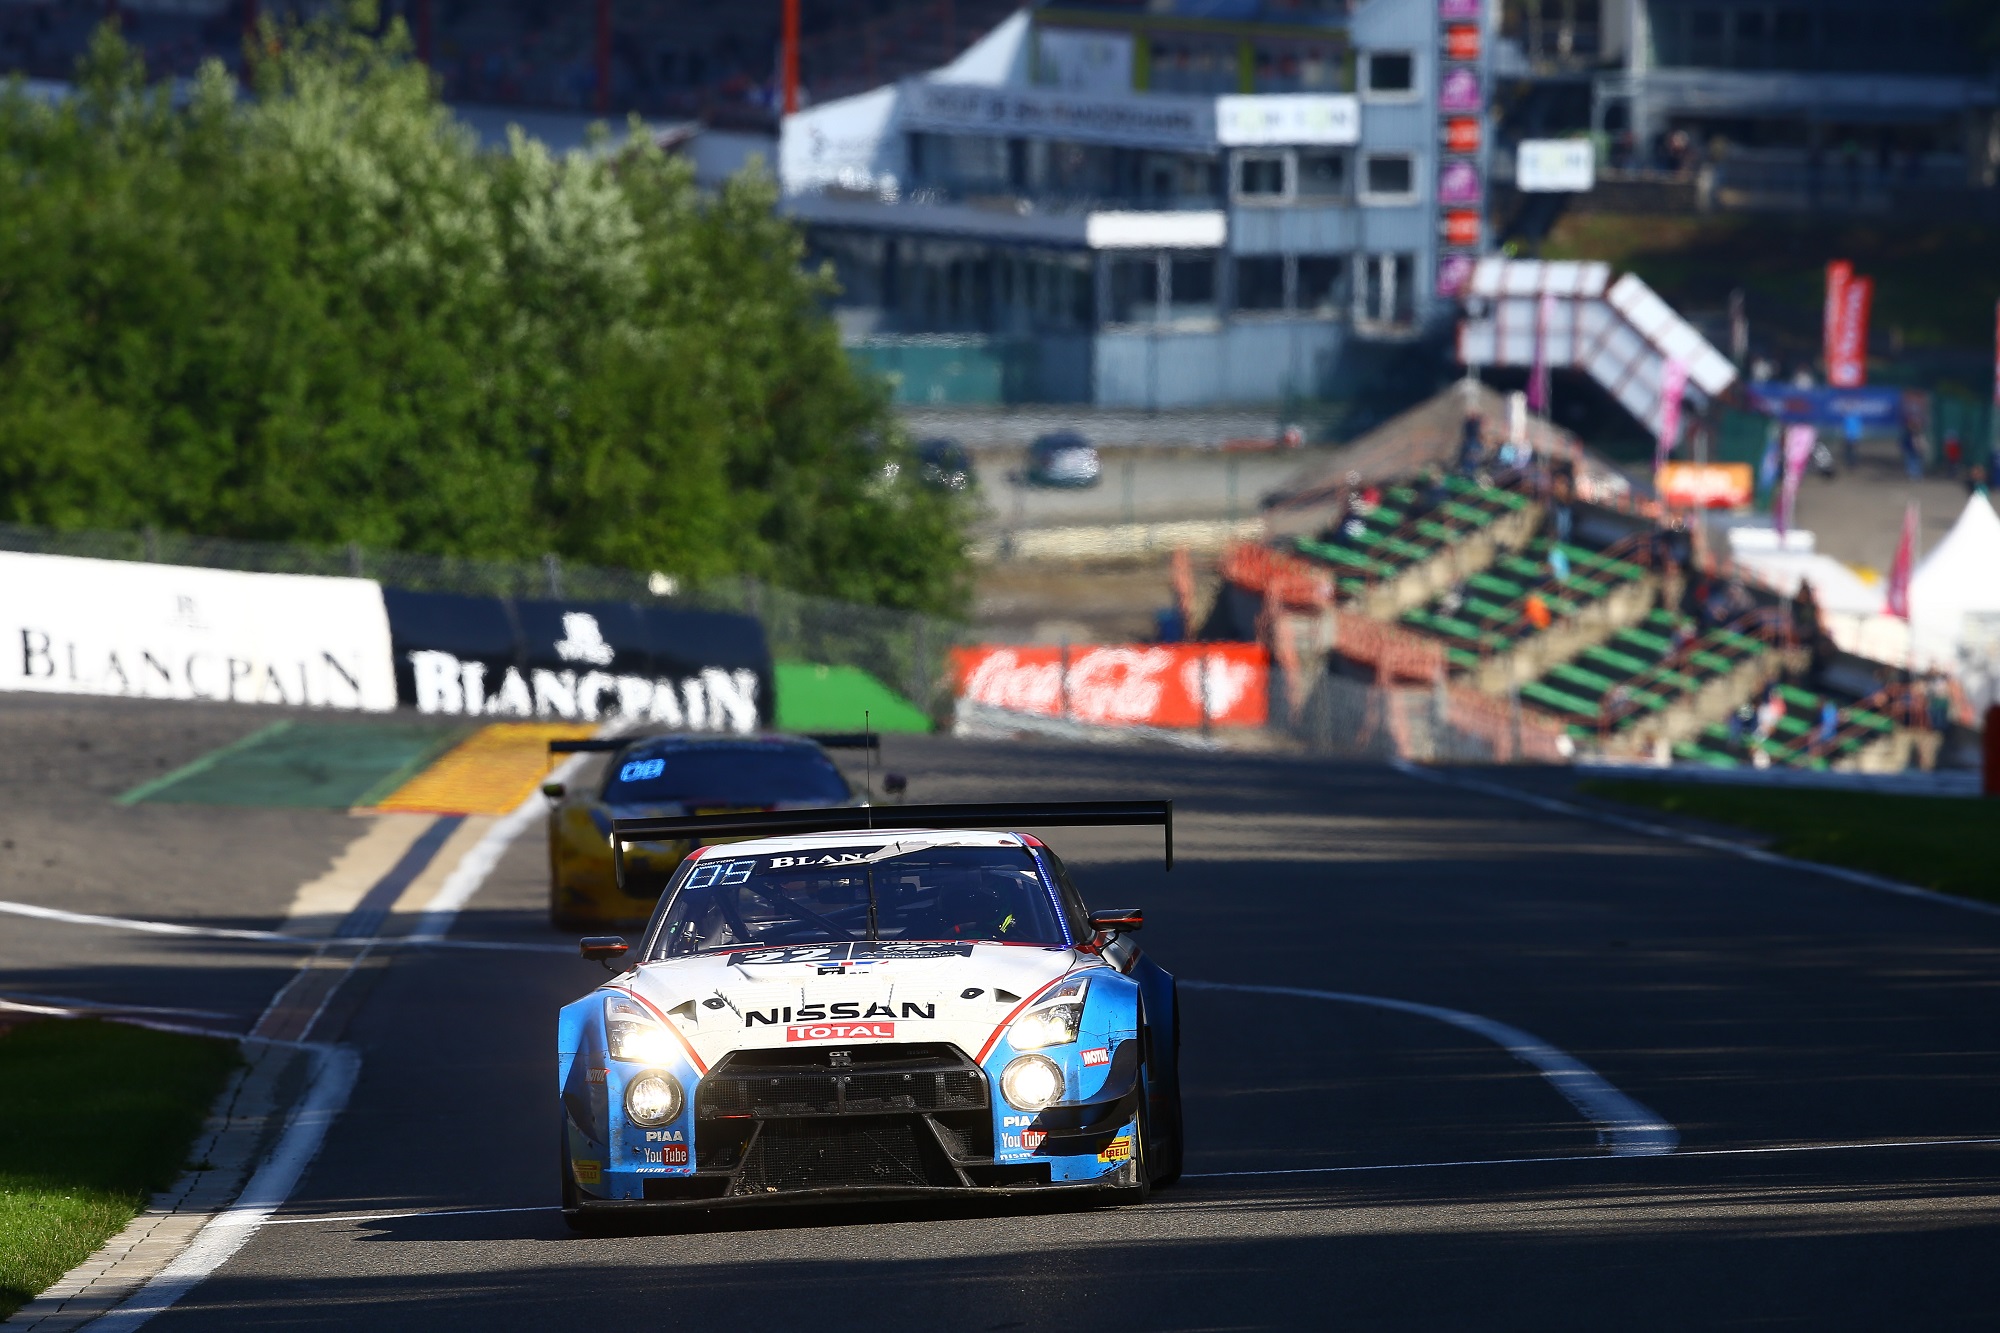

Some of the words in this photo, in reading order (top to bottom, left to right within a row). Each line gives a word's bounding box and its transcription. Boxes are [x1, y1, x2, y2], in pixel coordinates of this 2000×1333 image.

[20, 627, 362, 706] BLANCPAIN
[406, 648, 759, 733] BLANCPAIN
[743, 948, 831, 964] 22
[745, 1002, 935, 1027] NISSAN
[789, 1025, 892, 1040] TOTAL
[1083, 1048, 1109, 1065] MOTUL
[1003, 1115, 1043, 1127] PIAA
[645, 1130, 684, 1142] PIAA
